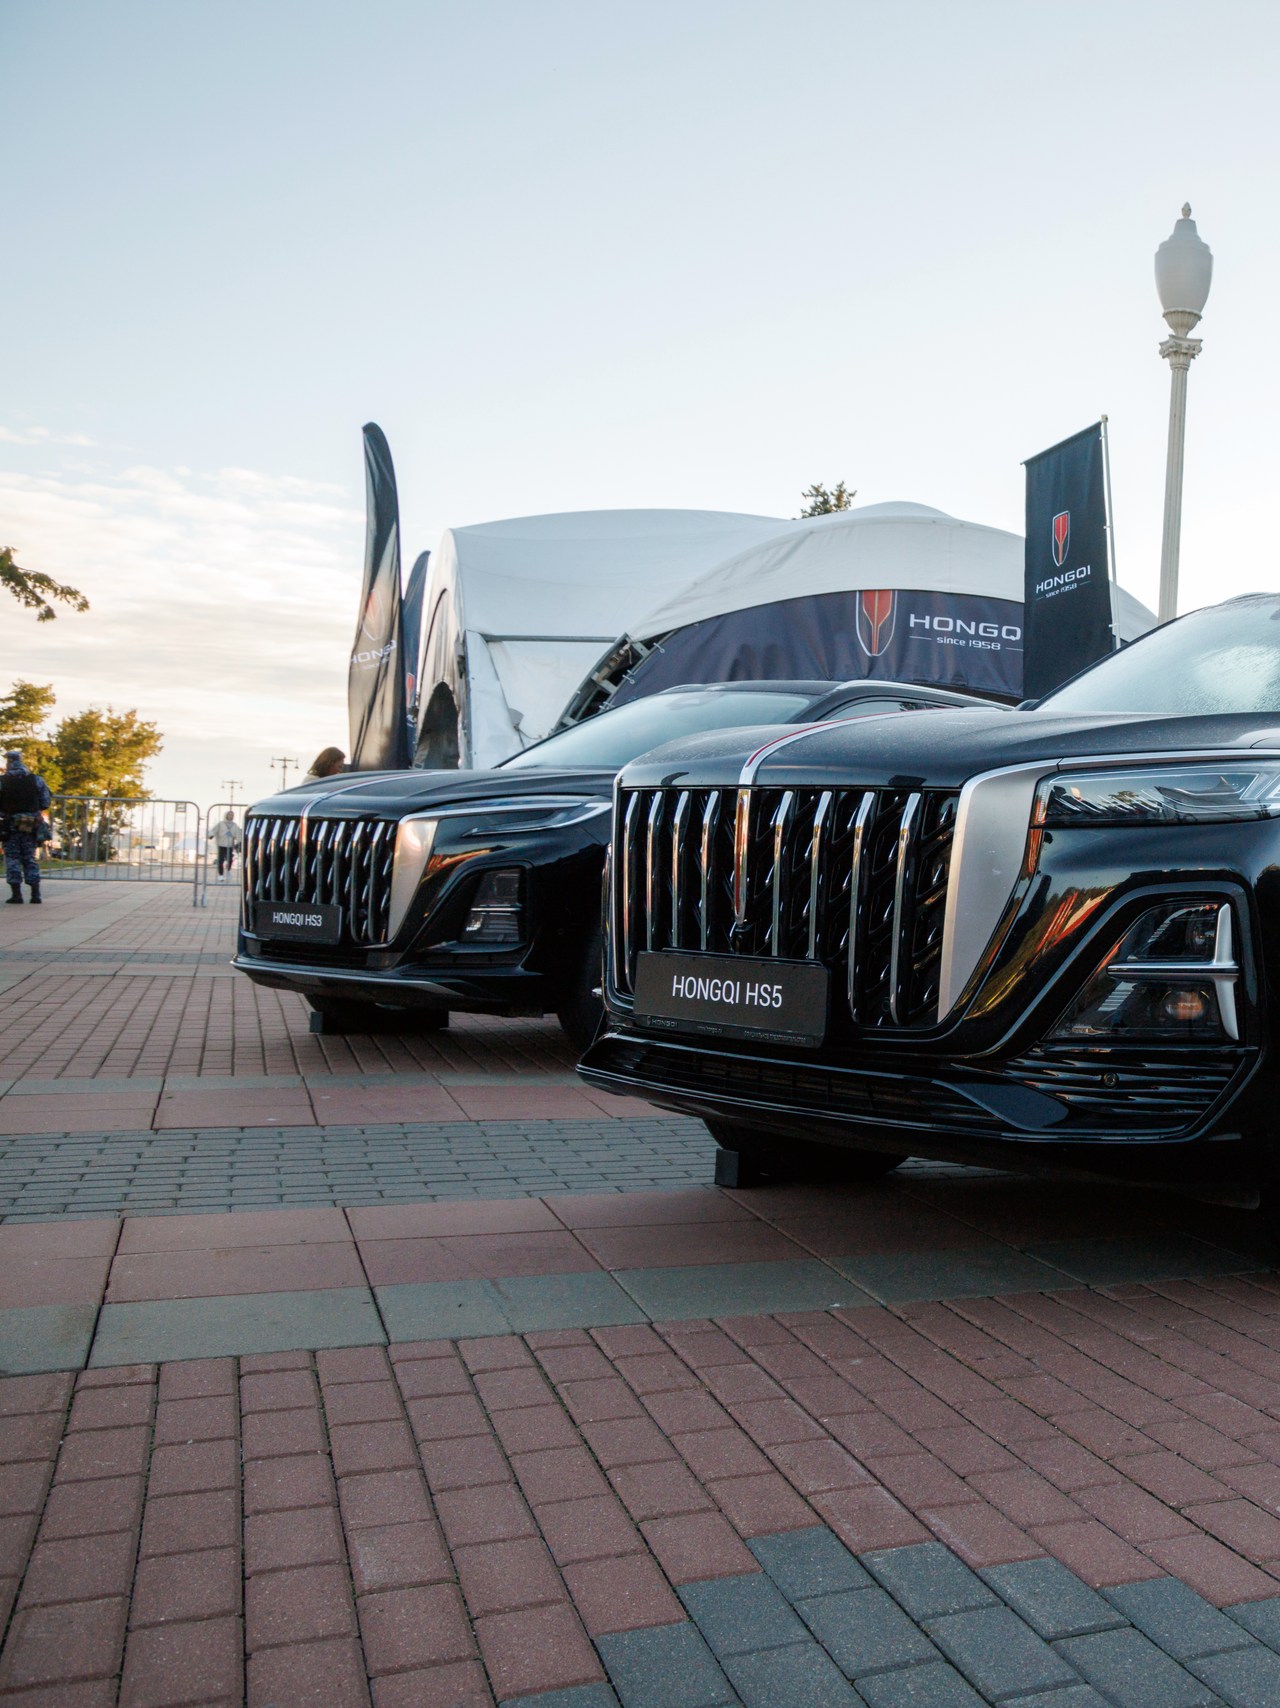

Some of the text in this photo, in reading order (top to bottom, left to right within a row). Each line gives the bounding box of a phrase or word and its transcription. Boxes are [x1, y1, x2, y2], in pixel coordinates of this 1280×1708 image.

[1035, 564, 1091, 594] HONGQI
[909, 613, 1022, 641] HONGQ
[936, 636, 1001, 651] since 1958
[272, 911, 323, 927] HONGQI HS3
[671, 975, 783, 1008] HONGQI HS5
